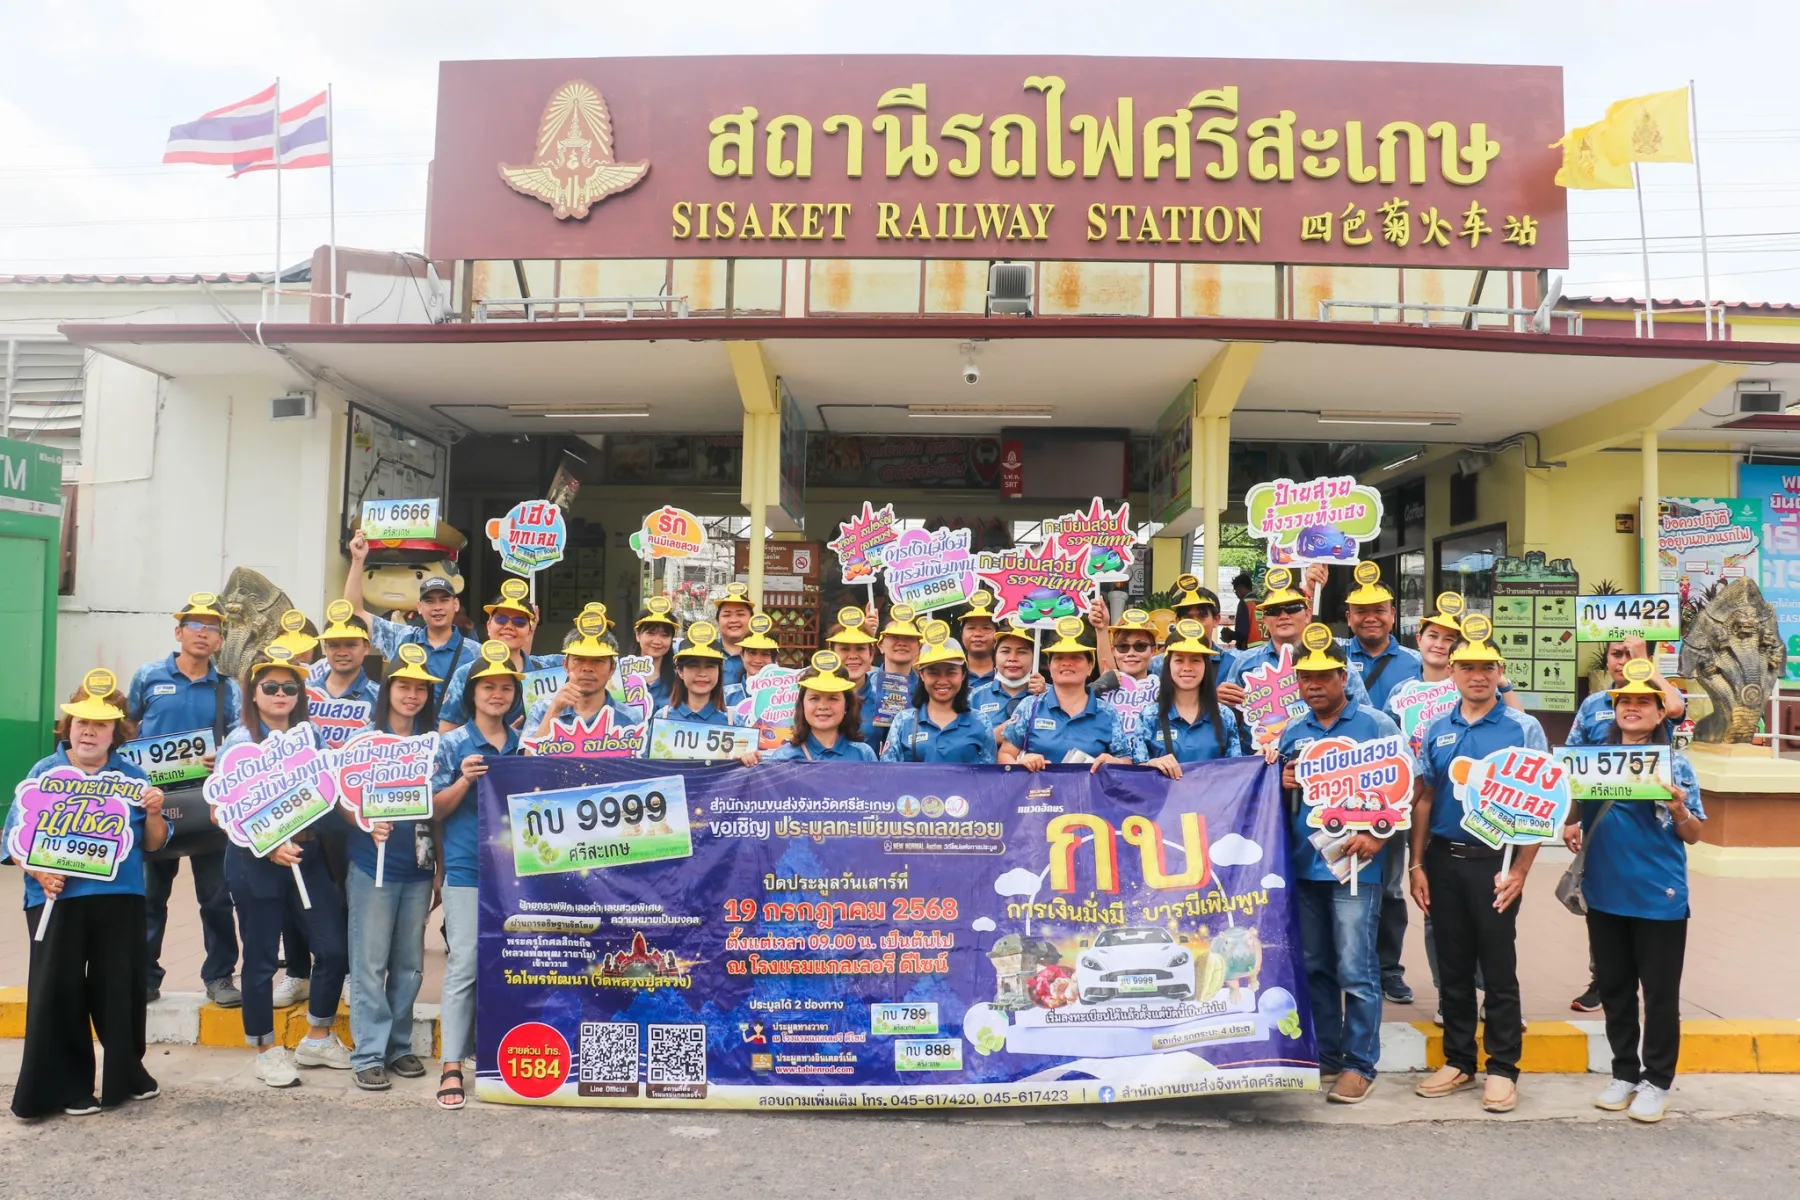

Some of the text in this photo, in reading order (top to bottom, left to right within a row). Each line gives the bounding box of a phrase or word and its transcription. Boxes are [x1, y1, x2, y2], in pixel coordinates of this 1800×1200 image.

[708, 75, 1500, 185] สถานีรถไฟศรีสะเกษ
[672, 201, 1262, 243] SISAKET RAILWAY STATION
[1300, 197, 1538, 248] 四色菊火车站
[1274, 480, 1352, 506] ป้ายสวย
[369, 504, 430, 521] กบ 6666
[518, 503, 556, 526] เฮง
[658, 508, 687, 536] รัก
[1261, 499, 1366, 533] ทั้งรวยทั้งเฮง
[1663, 512, 1728, 530] ข้อควรปฏิบัติ
[1045, 518, 1118, 533] ทะเบียนสวย
[509, 528, 557, 552] ทุกเลข
[647, 535, 699, 553] คนมีเลขสวย
[885, 531, 967, 562] การเงินมั่งมี
[889, 554, 975, 583] บารมีเพิ่มพูน
[980, 553, 1077, 573] ทะเบียนสวย
[906, 579, 956, 600] กบ 8888
[1584, 600, 1670, 620] กบ 4422
[534, 676, 557, 695] กบ
[1248, 702, 1273, 722] รวย
[1292, 706, 1305, 716] กบ
[149, 737, 206, 763] 9229
[333, 737, 434, 767] ทะเบียนสวย
[537, 729, 642, 754] หล่อ สปอร์ต
[674, 729, 735, 752] กบ 55
[209, 727, 309, 799] การเงินมั่งมี
[1301, 740, 1398, 779] ทะเบียนสวย
[1500, 751, 1563, 791] เฮง
[1563, 752, 1660, 775] กบ 5757
[346, 755, 428, 793] อยู่ดีกินดี
[1309, 765, 1397, 802] สาวๆ ชอบ
[41, 776, 142, 800] เลขทะเบียน
[220, 754, 329, 824] บารมีเพิ่มพูน
[369, 790, 420, 804] กบ 9999
[1479, 779, 1559, 819] ทุกเลข
[1590, 783, 1632, 797] ศรีสะเกษ
[37, 795, 125, 837] นำโชค
[251, 788, 312, 834] กบ 8888
[526, 790, 668, 837] กบ 9999
[710, 797, 894, 814] สำนักงานขนส่งจังหวัดศรีสะเกษ
[709, 815, 1003, 842] ขอเชิญ ประมูลทะเบียนรถเลขสวย
[1530, 819, 1550, 829] 9000
[41, 838, 108, 858] กบ 9999
[569, 842, 631, 864] ศรีสะเกษ
[1047, 812, 1211, 894] กบ
[763, 864, 908, 896] ปิดประมูลวันเสาร์ที่
[723, 897, 958, 929] 19 กรกฎาคม 2568
[1007, 884, 1268, 924] การเงินมั่งมี บารมีเพิ่มพูน
[611, 915, 699, 925] ความหมายเป็นมงคล
[726, 928, 954, 950] ตั้งแต่เวลา 09.00 น. เป็นต้นไป
[727, 951, 948, 975] ณ โรงแรมแกลเลอรี ดีไซน์
[504, 970, 692, 992] วัดไพรพัฒนา (วัดหลวงปู่สรวง)
[1133, 976, 1153, 985] 9999
[750, 999, 844, 1012] ประมูลได้ 2 ช่องทาง
[883, 1008, 926, 1021] กบ 789
[1221, 1028, 1227, 1036] 4
[1230, 1025, 1251, 1037] ประตู
[508, 1045, 561, 1056] สายด่วน โทร.
[906, 1044, 951, 1056] กบ 888
[507, 1058, 561, 1079] 1584
[776, 1066, 854, 1074] www.tabienrod.com
[590, 1085, 628, 1093] Line Official
[759, 1089, 1068, 1107] สอบถามเพิ่มเติม โทร. 045-617420, 045-617423
[1122, 1076, 1304, 1098] สำนักงานขนส่งจังหวัดศรีสะเกษ
